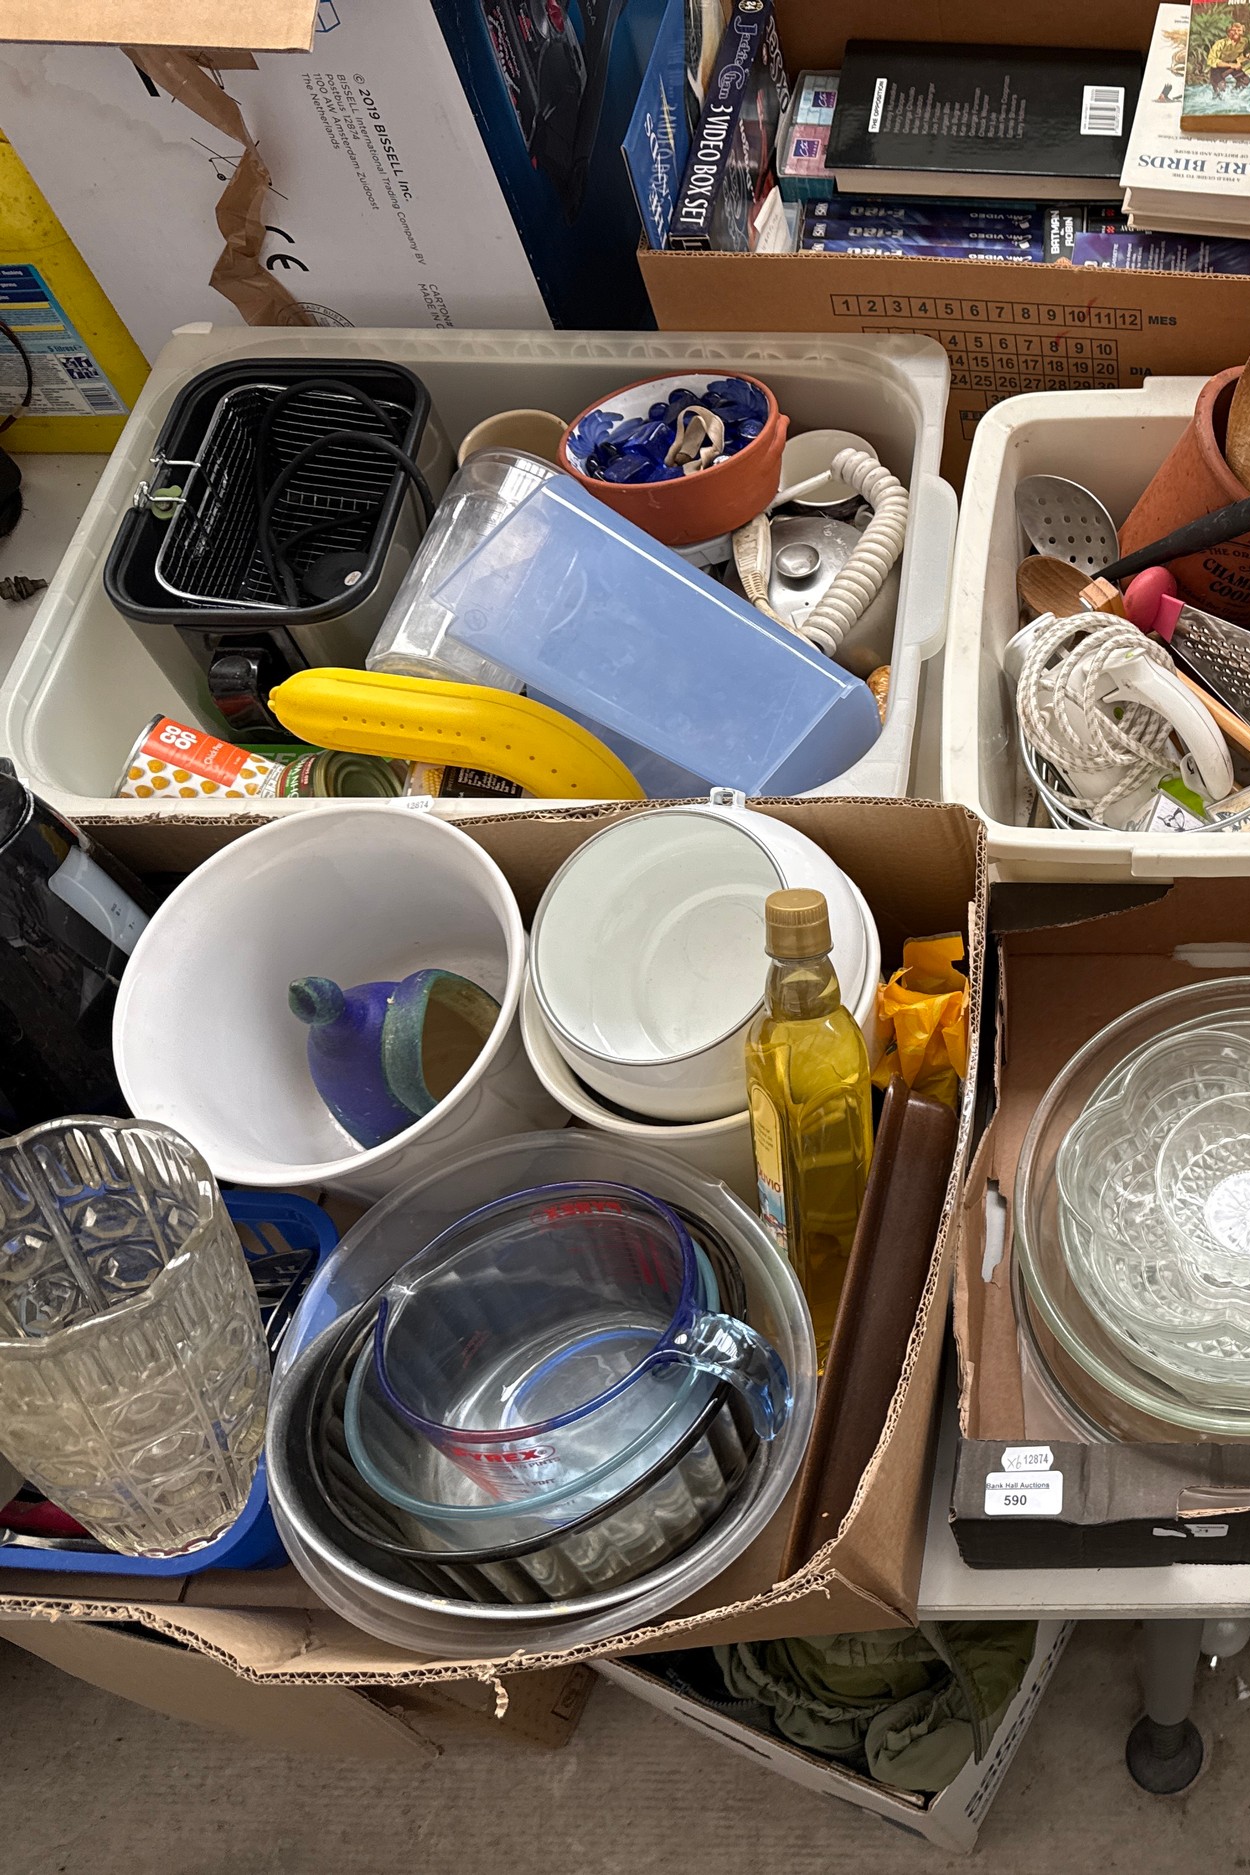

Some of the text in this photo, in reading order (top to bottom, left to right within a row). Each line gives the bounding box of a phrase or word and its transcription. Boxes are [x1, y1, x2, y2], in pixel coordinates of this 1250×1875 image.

[325, 73, 361, 140] Postbus 12874
[873, 80, 884, 117] OPPOSITION
[301, 72, 340, 150] The Netherlands
[680, 16, 757, 227] Jackie Chan 3 VIDEO BOX SET
[313, 72, 380, 210] 1100 AW Amsterdam Zuidoost
[359, 88, 412, 202] 2019 BISSELL Inc.
[336, 73, 427, 266] BISSELL International Trading Company BV
[1138, 154, 1206, 172] BIRDS
[969, 212, 1004, 220] VIDEO
[1050, 210, 1060, 255] BATMAN
[1065, 216, 1074, 247] ROBIN
[968, 253, 1004, 261] VIDEO
[417, 283, 433, 311] MADE
[843, 300, 1177, 326] 1 2 3 4 5 6 7 8 9 10 11 12 MES
[948, 335, 1112, 355] 4 5 6 7 8 9 10
[973, 356, 989, 368] 15
[998, 357, 1014, 369] 16
[1022, 359, 1039, 371] 17
[1048, 360, 1064, 372] 18
[1073, 361, 1088, 374] 19
[1096, 363, 1115, 375] 20
[1130, 366, 1152, 376] DIA
[950, 374, 968, 386] 24
[974, 375, 993, 388] 25
[999, 376, 1017, 389] 26
[1023, 378, 1042, 390] 27
[1049, 379, 1067, 391] 28
[1073, 381, 1091, 390] 29
[1208, 547, 1229, 556] THE
[406, 800, 429, 809] 12874
[451, 1447, 541, 1463] PYREX
[1024, 1454, 1049, 1465] 12874
[1003, 1495, 1027, 1506] 590
